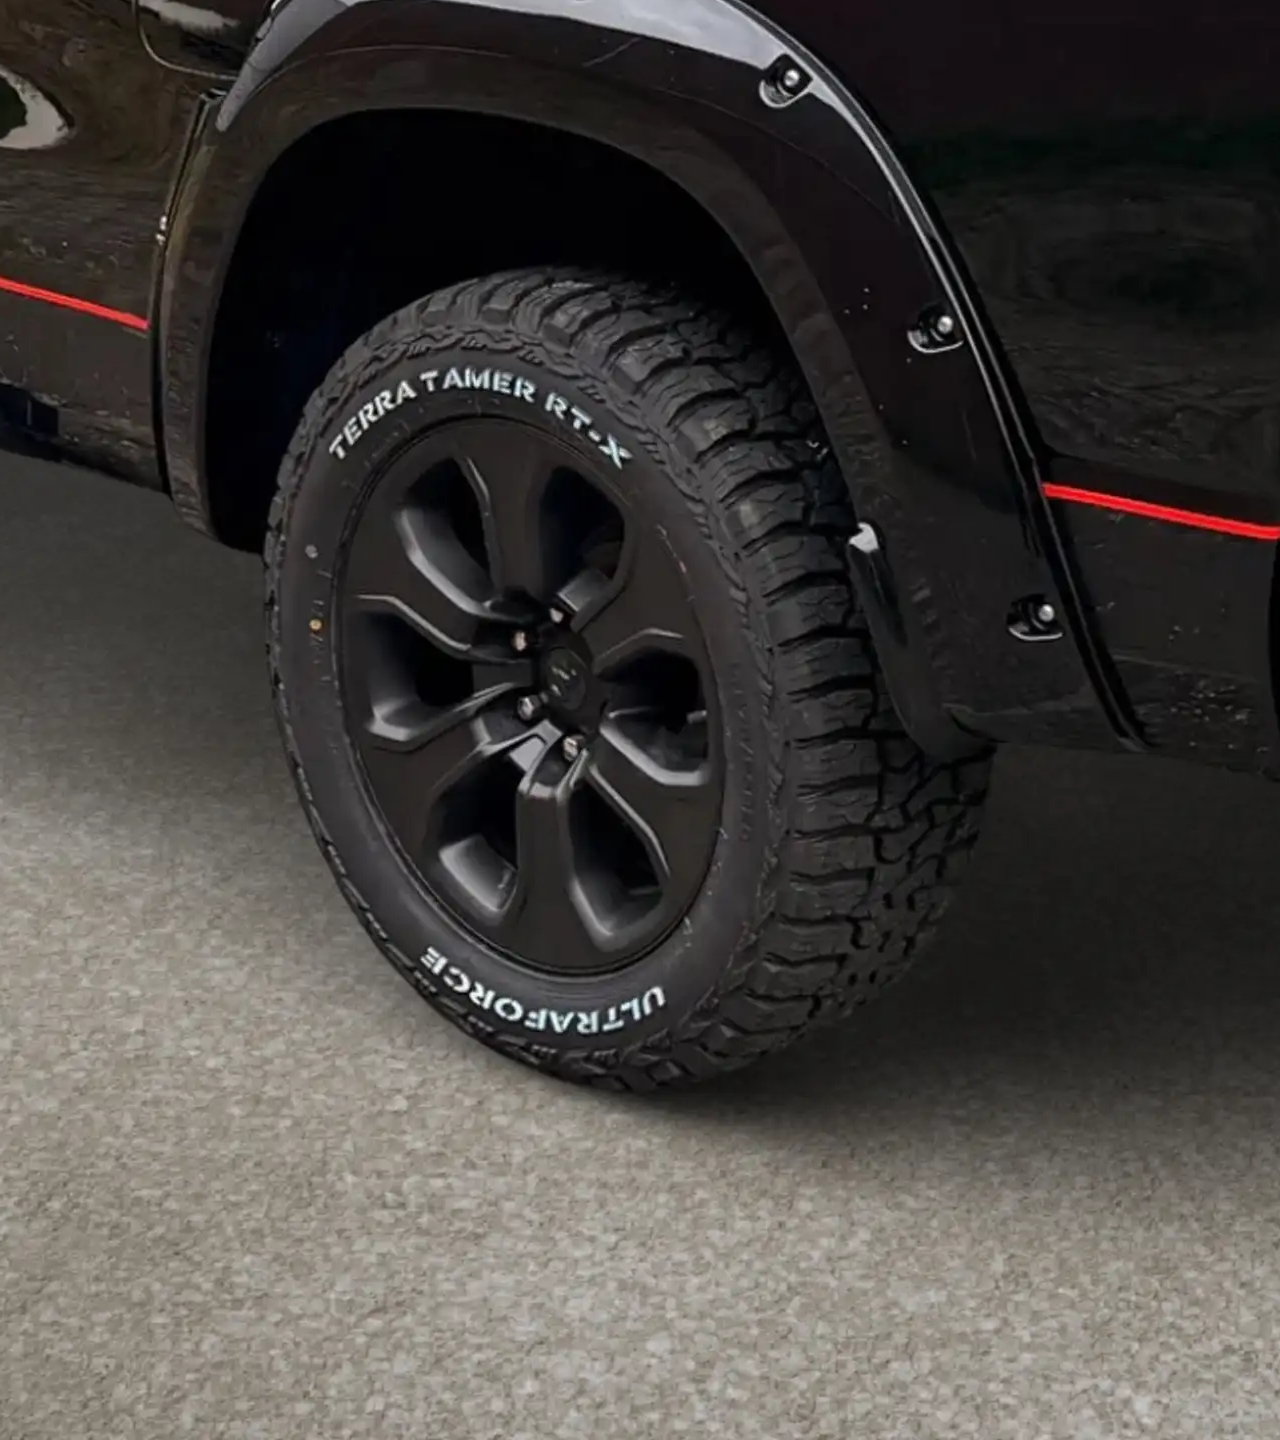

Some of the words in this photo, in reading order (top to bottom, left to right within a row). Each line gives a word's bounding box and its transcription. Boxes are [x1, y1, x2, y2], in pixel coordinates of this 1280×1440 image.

[328, 379, 418, 460] TERRA
[420, 367, 538, 403] TAMER
[544, 391, 633, 469] RT-X
[421, 945, 667, 1034] ULTRAFORCE
